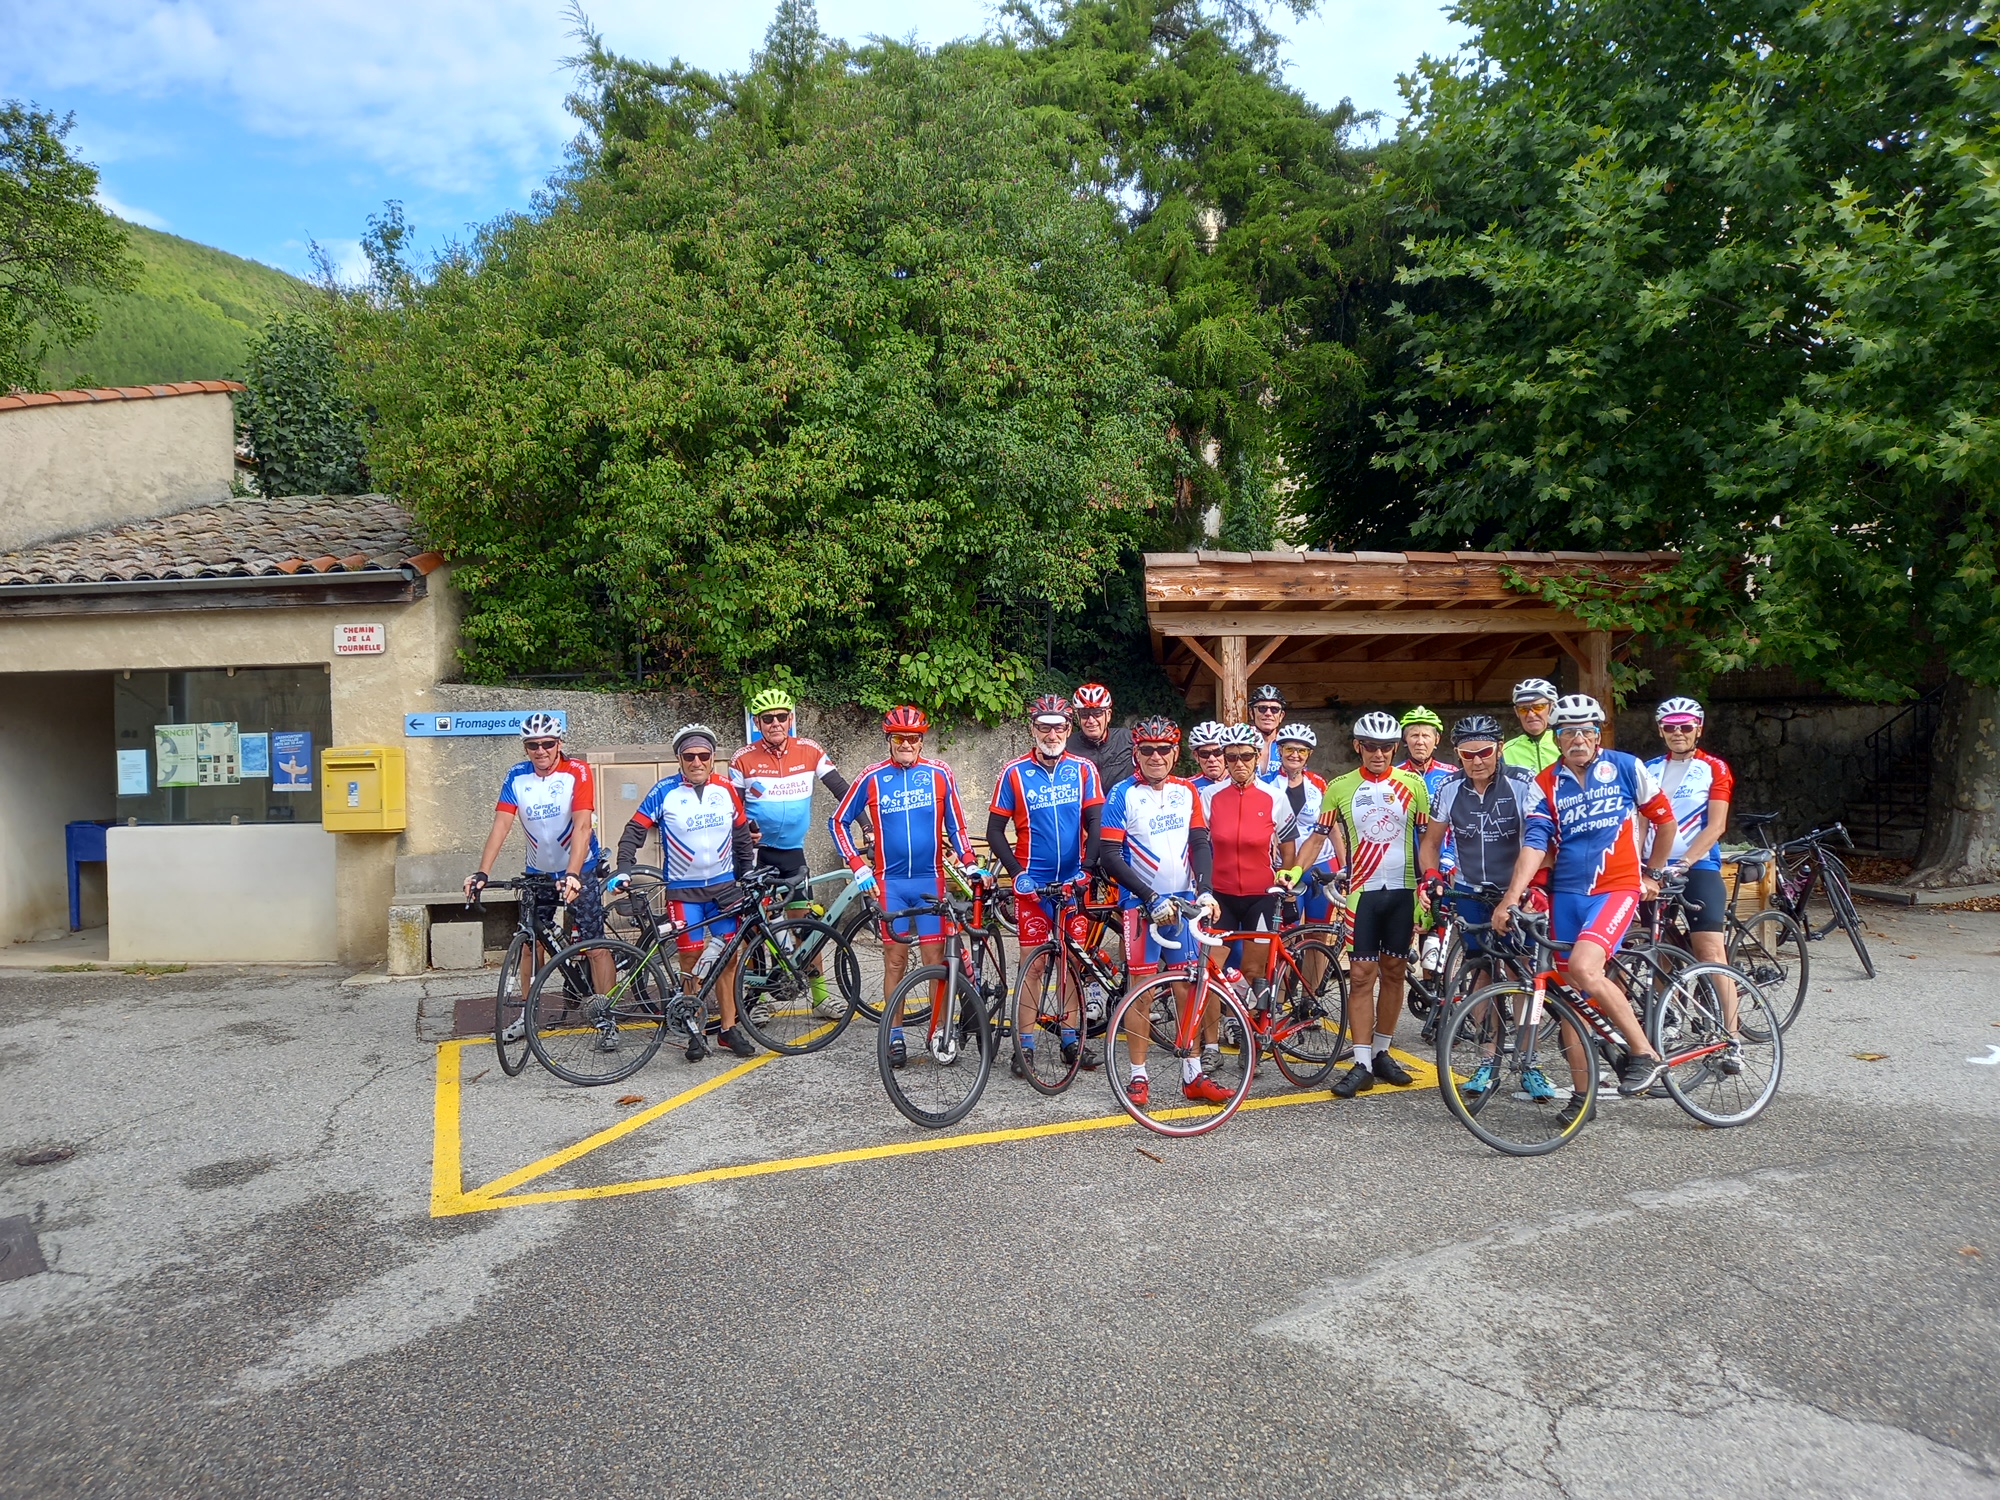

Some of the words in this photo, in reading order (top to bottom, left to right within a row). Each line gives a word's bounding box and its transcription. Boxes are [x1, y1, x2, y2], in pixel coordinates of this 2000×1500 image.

[343, 626, 374, 634] CHEMIN
[337, 644, 381, 652] TOURNELLE
[454, 717, 506, 731] Fromages
[156, 728, 194, 737] ONCERT
[768, 785, 809, 796] MONDIALE
[893, 788, 925, 798] Garage
[1039, 783, 1072, 794] Garage
[891, 798, 900, 808] St
[902, 792, 933, 805] ROCH
[1038, 794, 1048, 803] St
[1050, 787, 1079, 801] ROCH
[1557, 783, 1620, 810] Alimentation
[533, 802, 554, 810] Garage
[533, 809, 540, 817] St
[542, 805, 560, 815] ROCH
[694, 812, 716, 820] Garage
[1155, 812, 1177, 822] Garage
[1361, 807, 1377, 823] CLUB
[1377, 806, 1400, 822] CYCLO
[695, 819, 702, 827] St
[704, 815, 724, 825] ROCH
[1157, 821, 1164, 829] St
[1165, 816, 1184, 827] ROCH
[1123, 921, 1132, 961] PORSPODER
